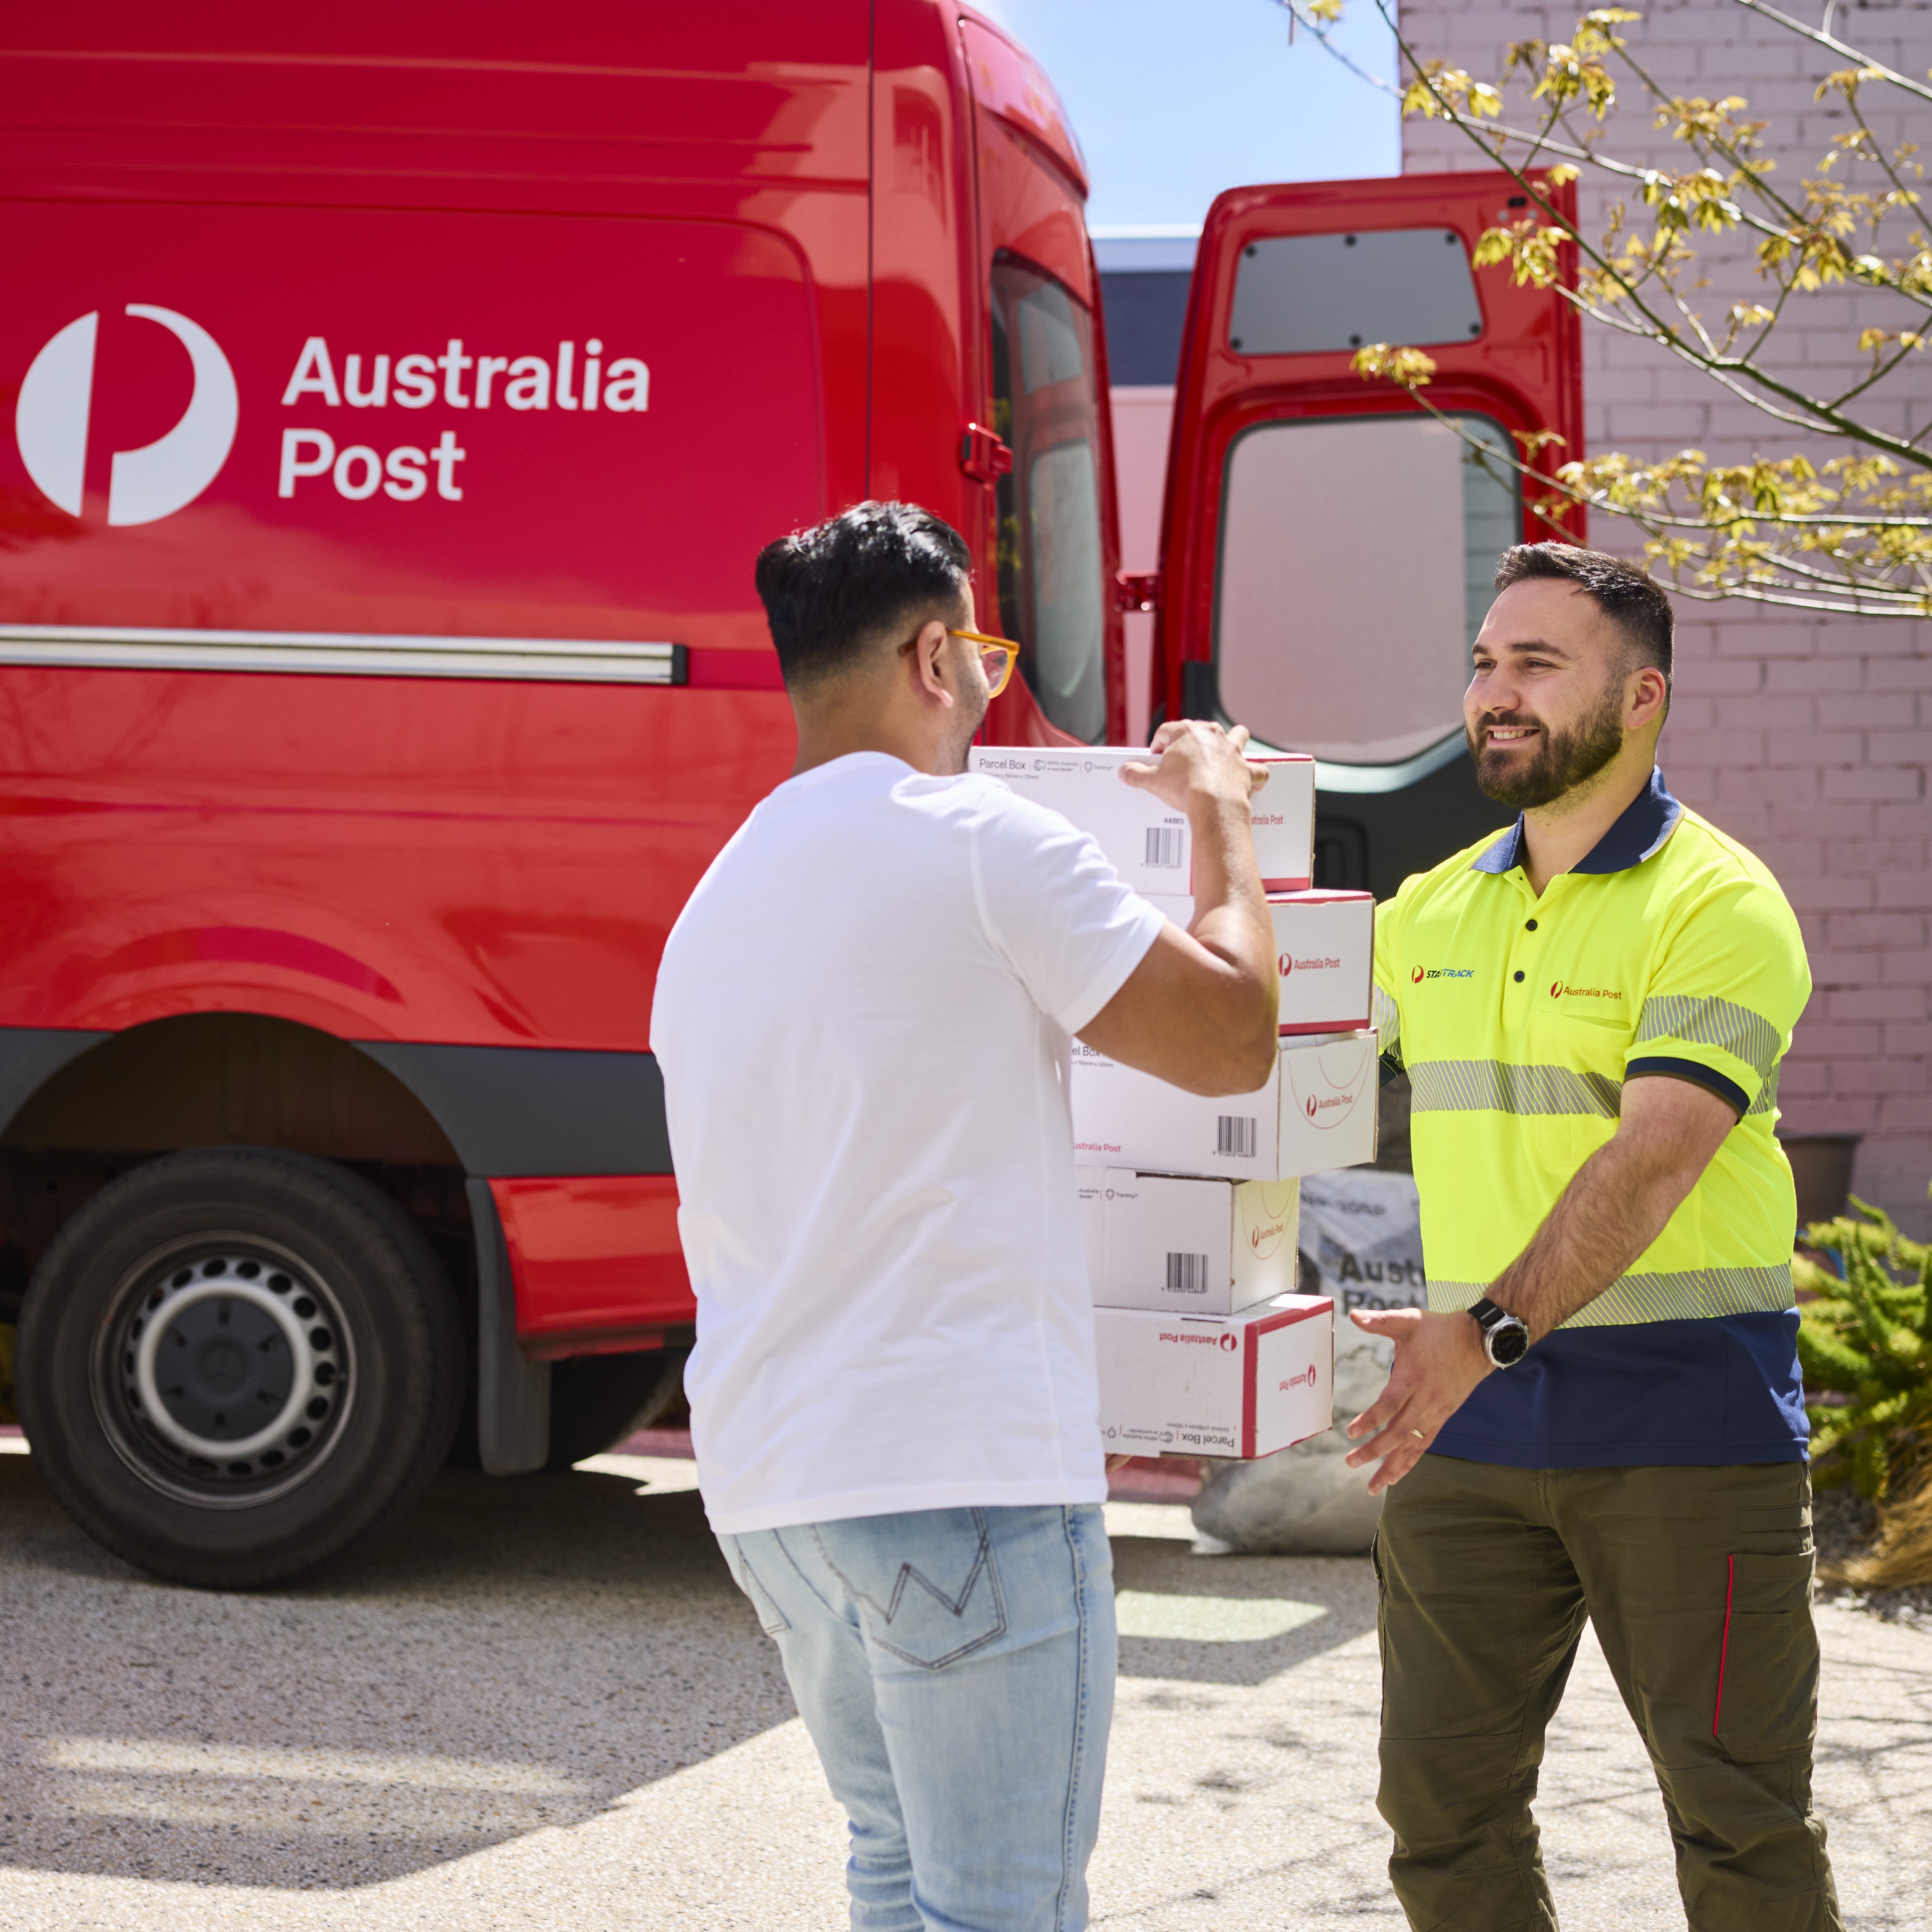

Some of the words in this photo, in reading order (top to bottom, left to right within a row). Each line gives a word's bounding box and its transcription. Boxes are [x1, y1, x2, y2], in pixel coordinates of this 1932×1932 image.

[281, 337, 650, 412] Australia
[278, 428, 465, 501] Post
[980, 759, 1007, 769] Parcel
[1009, 760, 1026, 770] Box
[1251, 815, 1268, 825] stralia
[1270, 815, 1283, 825] Post
[1294, 958, 1323, 970] Australia
[1325, 957, 1340, 968] Post
[1563, 986, 1600, 997] Australia
[1602, 990, 1622, 1000] Post
[1318, 1096, 1340, 1109] Australia
[1341, 1093, 1353, 1105] Post
[1073, 1142, 1102, 1151] ustralia
[1103, 1143, 1121, 1153] Post
[1260, 1226, 1274, 1239] Australia
[1275, 1223, 1283, 1234] Post
[1339, 1252, 1424, 1286] Aust
[1159, 1333, 1178, 1342] Post
[1180, 1334, 1217, 1346] Australia
[1279, 1379, 1288, 1393] Post
[1289, 1373, 1306, 1388] Australia
[1181, 1433, 1200, 1445] Box
[1203, 1435, 1234, 1448] Parcel
